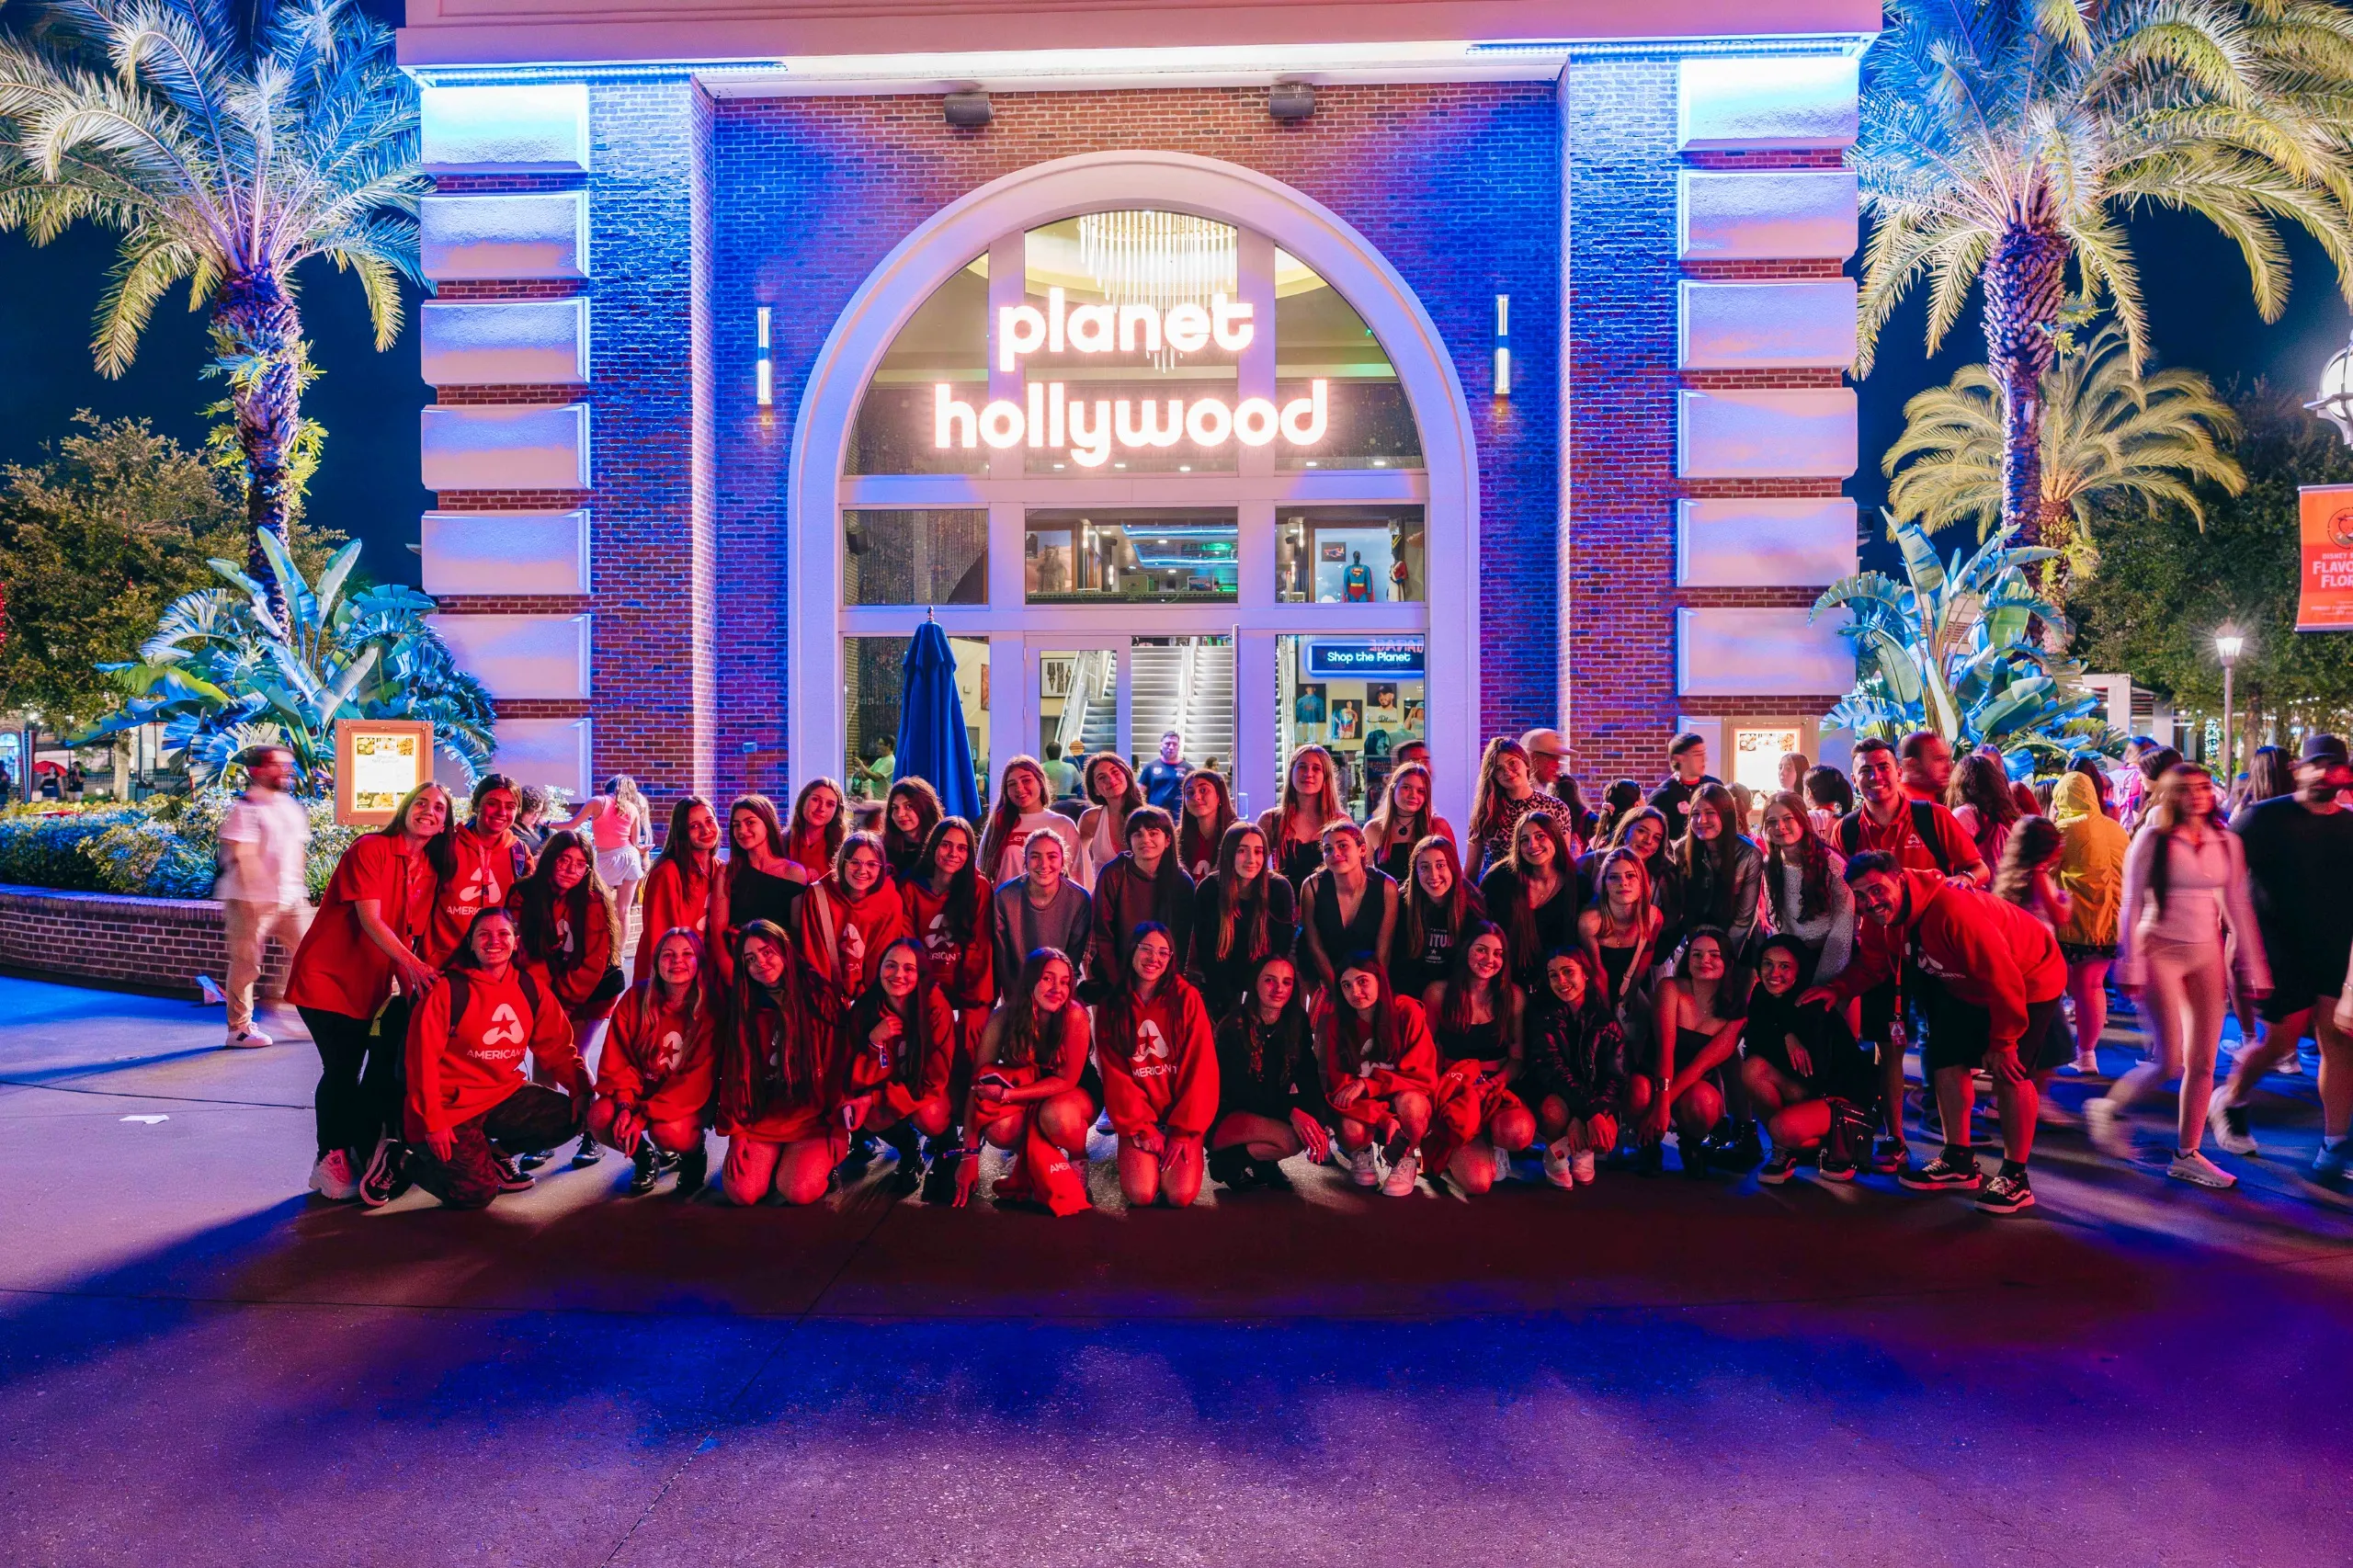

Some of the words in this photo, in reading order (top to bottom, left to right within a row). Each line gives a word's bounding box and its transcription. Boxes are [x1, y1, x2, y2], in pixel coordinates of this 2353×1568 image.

[998, 287, 1254, 371] planet
[934, 379, 1328, 468] hollywood
[1327, 651, 1354, 664] Shop
[1356, 652, 1374, 662] the
[1377, 652, 1411, 662] Planet
[1132, 1063, 1172, 1077] MERICAN
